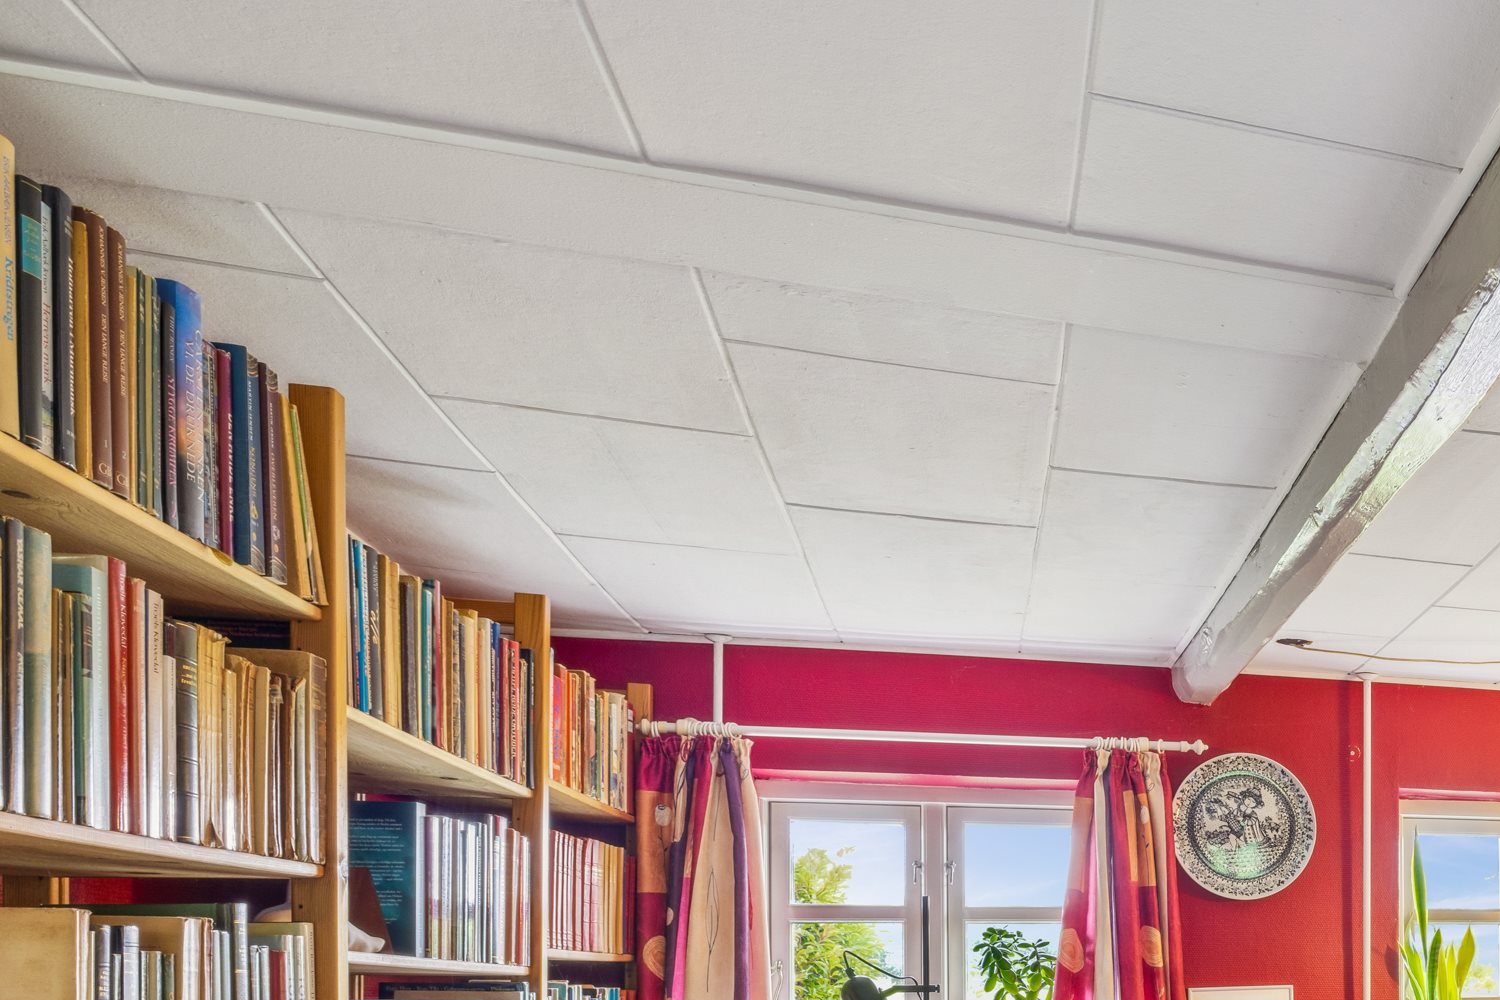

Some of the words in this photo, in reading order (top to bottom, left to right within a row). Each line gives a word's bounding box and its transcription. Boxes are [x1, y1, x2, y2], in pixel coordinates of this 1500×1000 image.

[116, 242, 124, 282] JOHANNES
[4, 257, 14, 341] Kridtstregen
[42, 302, 50, 350] Herrens
[168, 376, 176, 423] STYGGE
[185, 363, 195, 390] DE
[168, 426, 176, 486] KRUMPEN
[185, 391, 195, 482] DRUKNEDE
[15, 539, 24, 584] YASHAR
[16, 587, 24, 630] KEMAL
